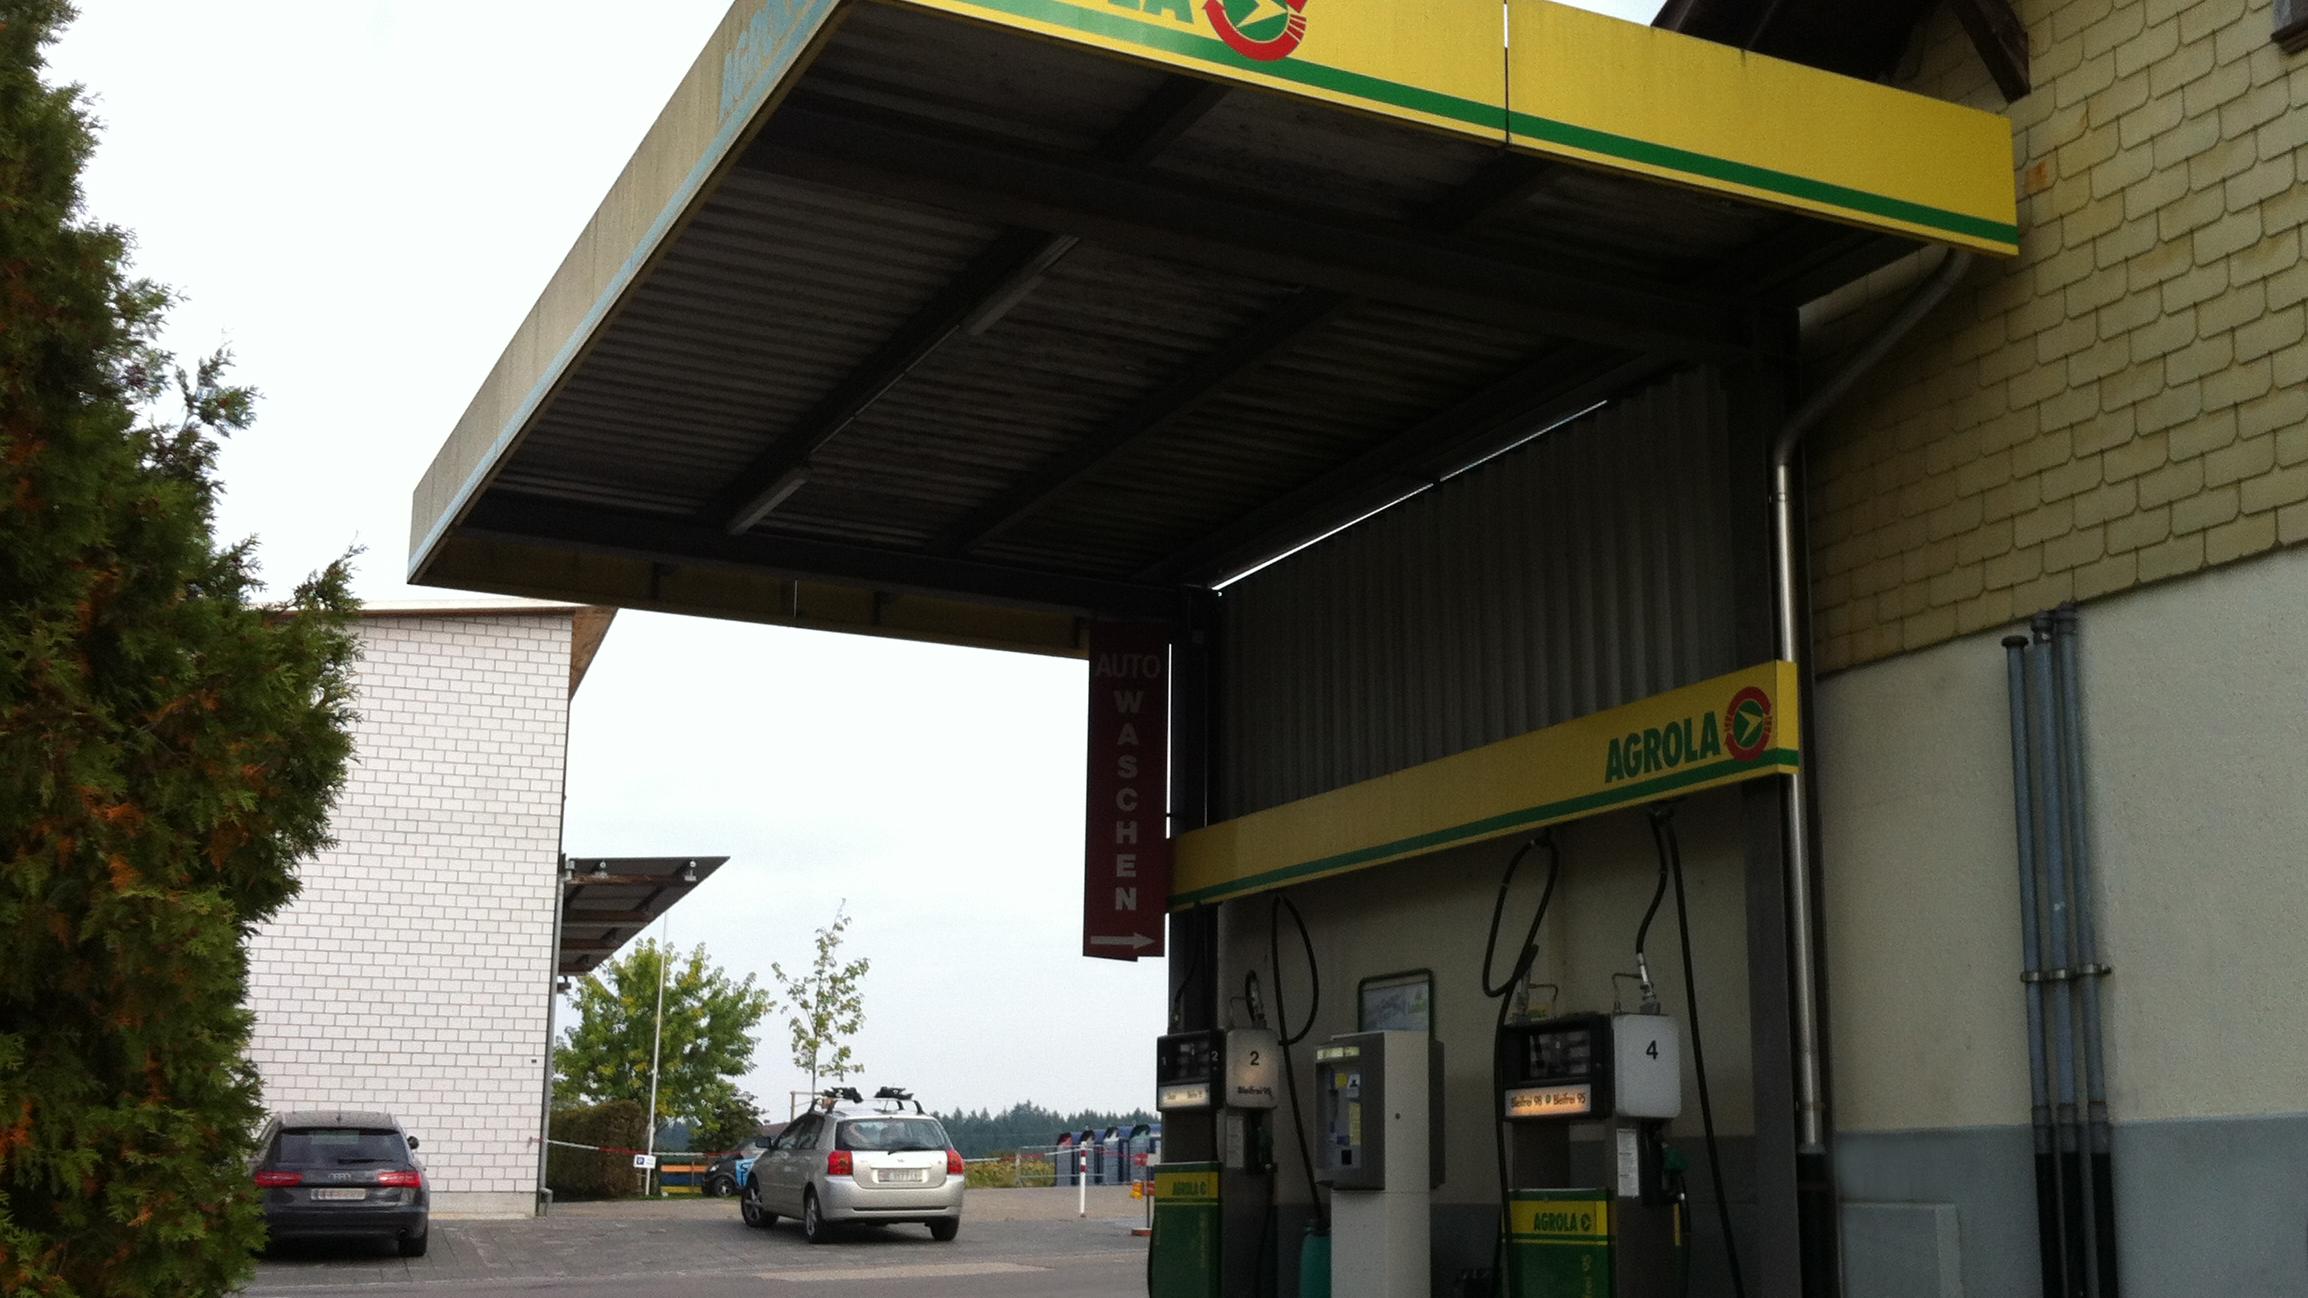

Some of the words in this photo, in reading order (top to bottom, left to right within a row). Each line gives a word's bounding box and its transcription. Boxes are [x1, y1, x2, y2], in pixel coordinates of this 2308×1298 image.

[1095, 654, 1161, 679] AUTO
[1604, 711, 1721, 783] AGROLA
[1113, 690, 1144, 911] WASCHEN
[1211, 1050, 1219, 1062] 2
[1249, 1051, 1260, 1066] 2
[1645, 1040, 1658, 1060] 4
[1533, 1212, 1578, 1232] AGROLA
